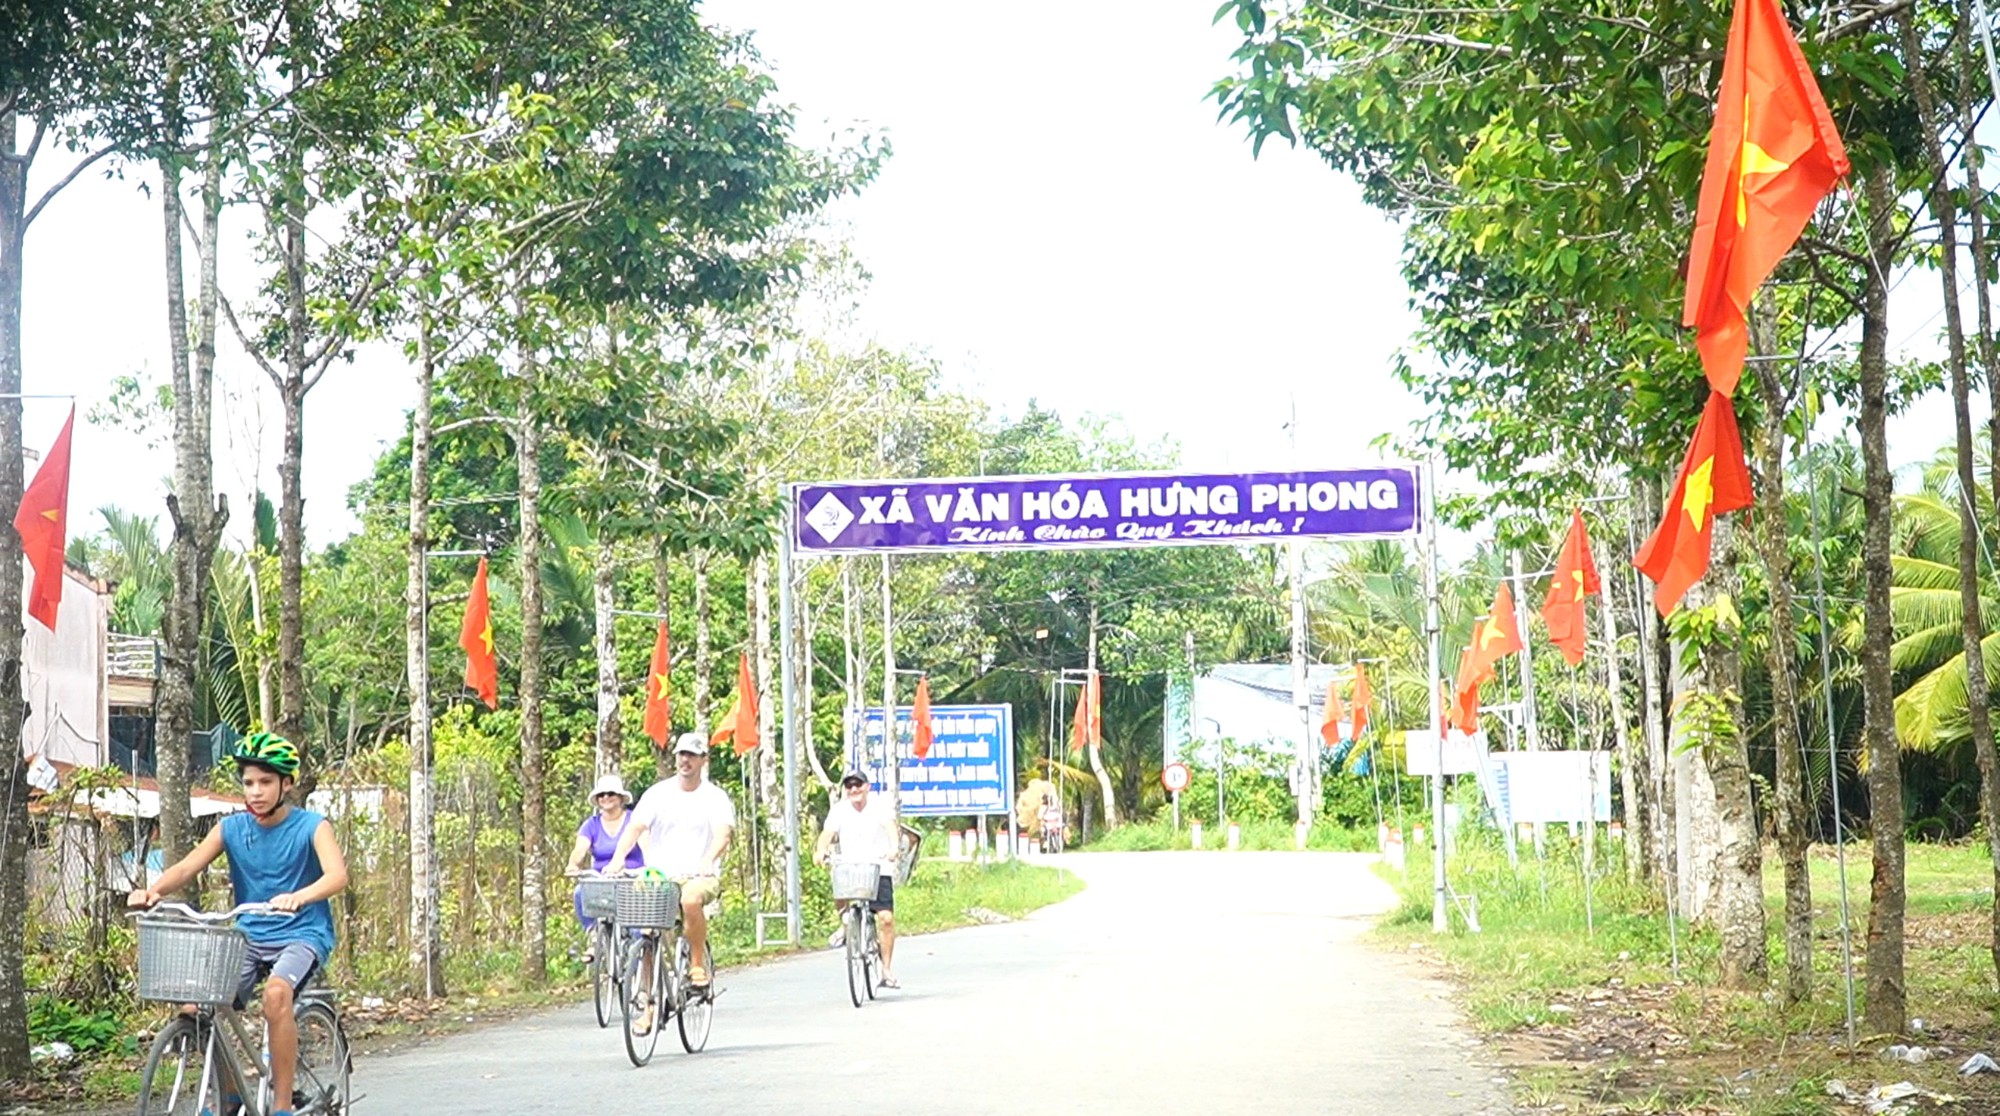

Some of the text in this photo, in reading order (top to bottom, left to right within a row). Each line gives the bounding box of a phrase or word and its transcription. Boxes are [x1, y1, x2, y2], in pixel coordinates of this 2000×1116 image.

[858, 480, 1398, 525] XÃ VĂN HÓA HƯNG PHONG
[948, 525, 1026, 542] Kính
[1033, 524, 1106, 542] Chào
[1116, 521, 1174, 540] Quý
[1181, 517, 1285, 536] Khách
